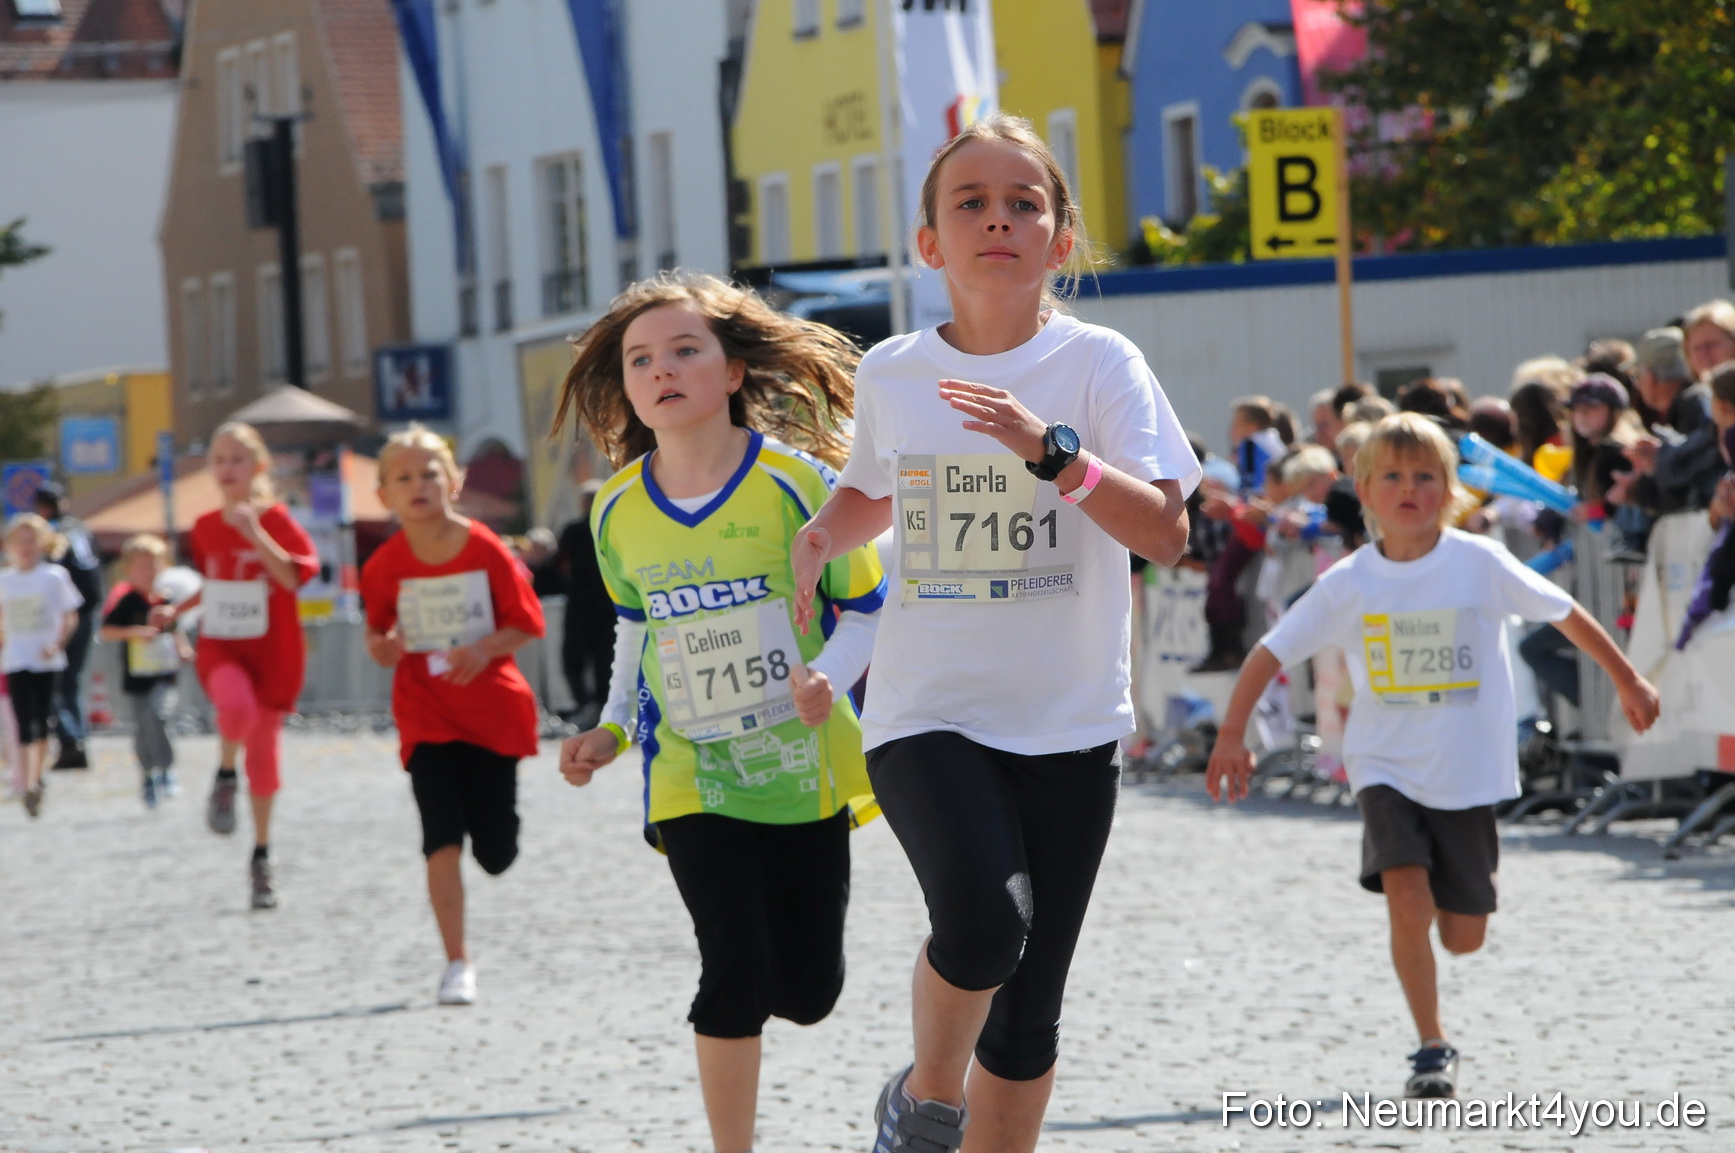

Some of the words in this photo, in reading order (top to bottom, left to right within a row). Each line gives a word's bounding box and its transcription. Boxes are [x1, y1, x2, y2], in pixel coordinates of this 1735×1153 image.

[1259, 115, 1329, 144] Block
[1276, 155, 1321, 223] B
[946, 465, 1007, 493] Carla
[906, 510, 926, 531] K5
[950, 509, 1057, 551] 7161
[635, 556, 715, 587] TEAM
[1011, 573, 1073, 590] PFLEIDERER
[647, 574, 773, 620] BOCK
[917, 583, 963, 594] BOCK
[685, 628, 742, 655] Celina
[1398, 645, 1472, 674] 7286
[666, 672, 682, 691] K5
[696, 649, 790, 700] 7158
